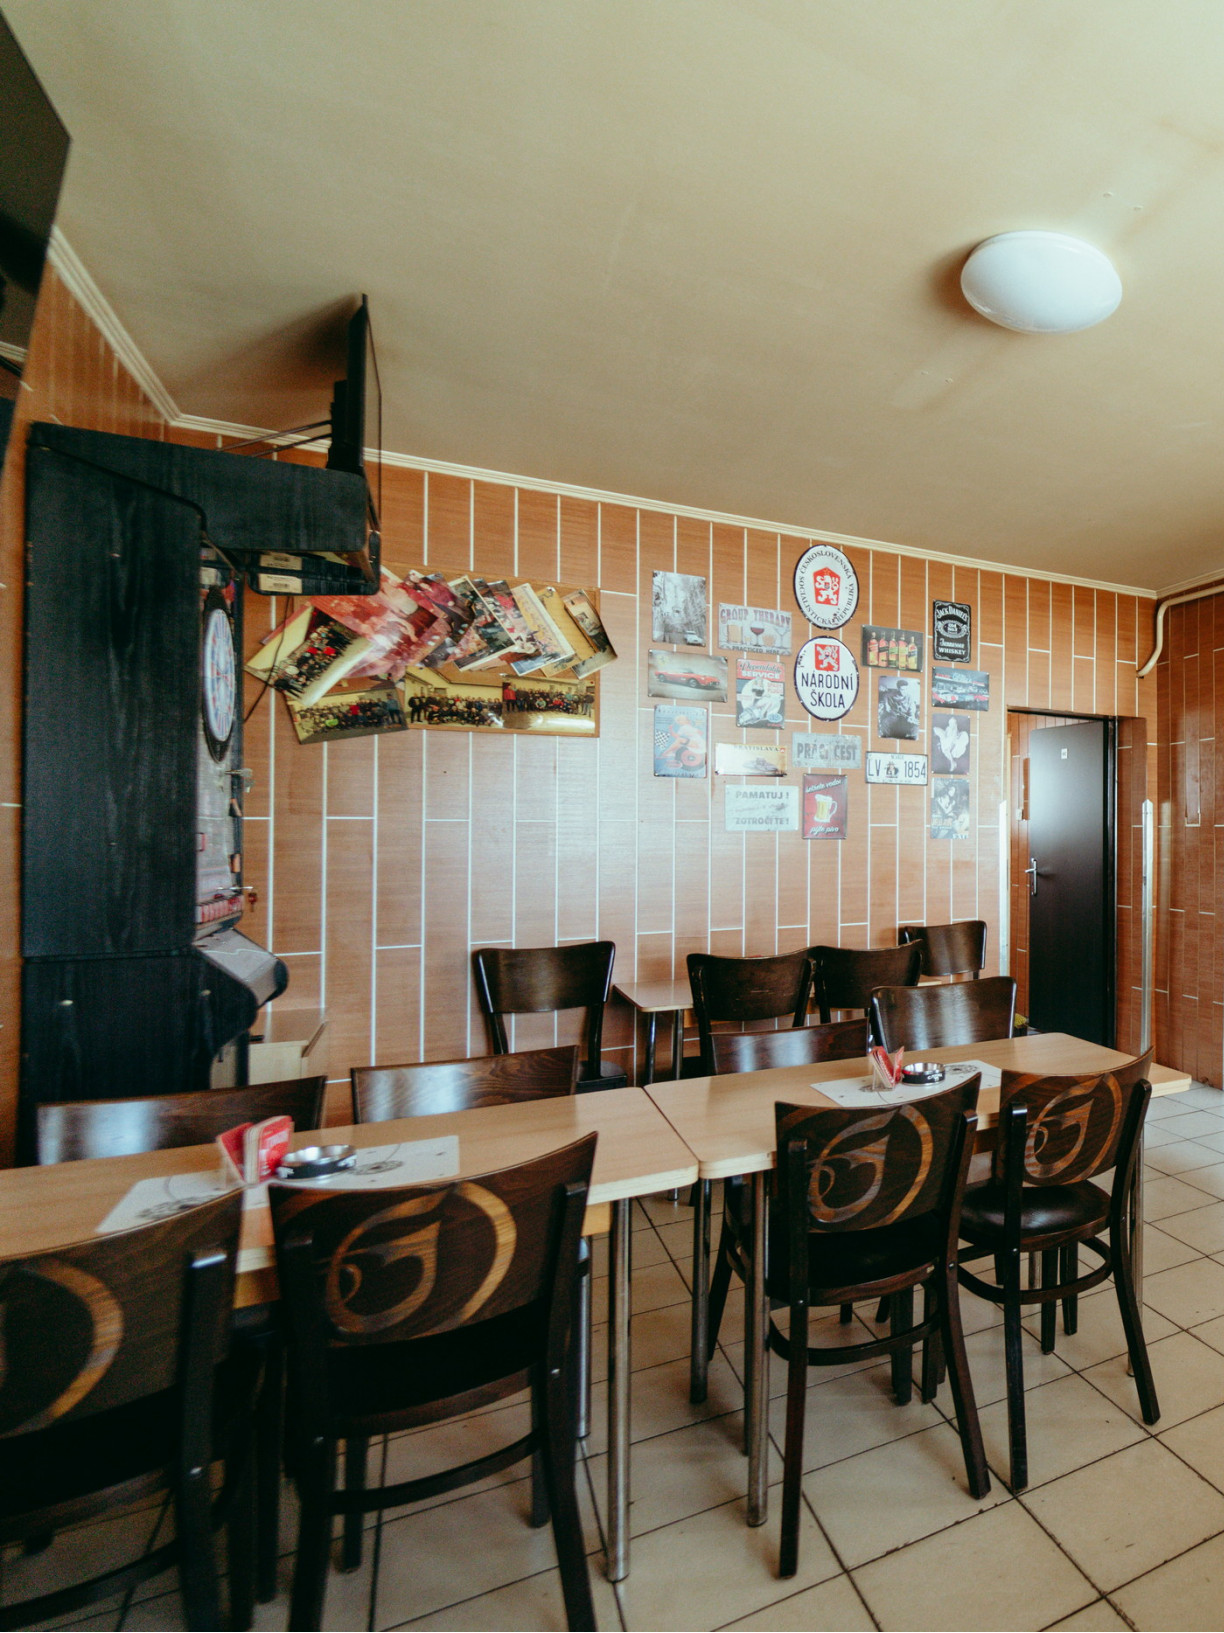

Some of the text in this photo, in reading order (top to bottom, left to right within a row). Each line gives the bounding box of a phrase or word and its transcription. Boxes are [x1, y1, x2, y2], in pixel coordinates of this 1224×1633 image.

[720, 608, 791, 628] GROUP THERAPY
[938, 647, 966, 655] WHISKEY
[742, 670, 780, 679] SERVICE
[801, 670, 853, 690] NÁRODNÍ
[810, 689, 845, 708] ŠKOLA
[834, 741, 858, 760] ČEST
[868, 759, 926, 778] LV 1854
